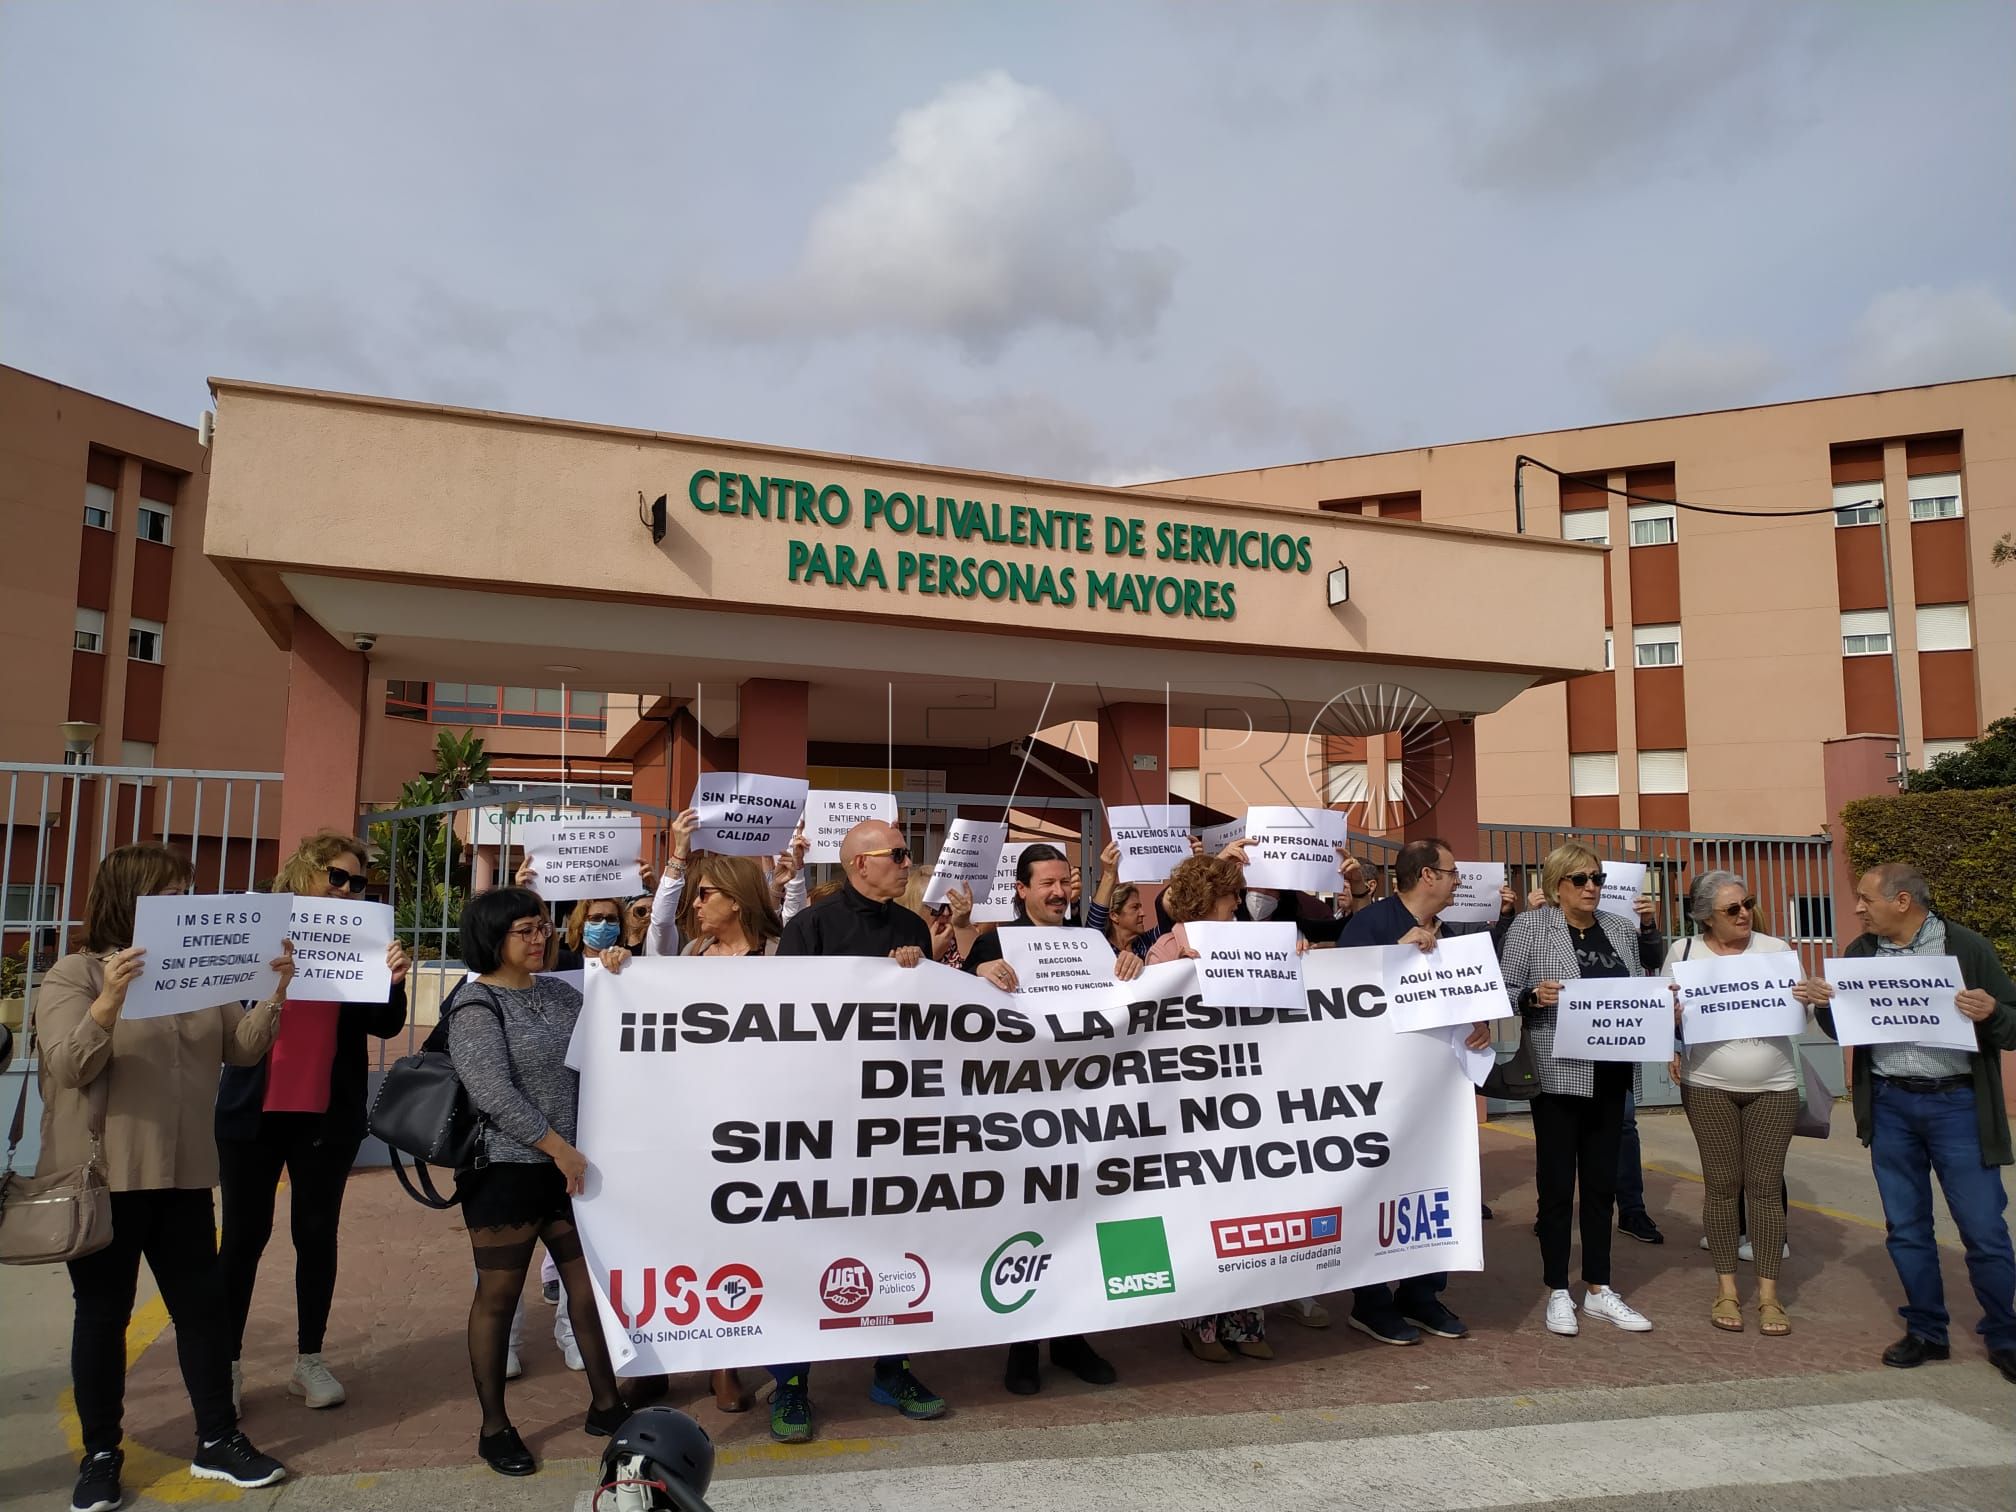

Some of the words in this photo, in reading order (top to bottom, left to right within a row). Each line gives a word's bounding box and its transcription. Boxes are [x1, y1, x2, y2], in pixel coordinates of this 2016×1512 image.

[689, 469, 850, 525] CENTRO
[864, 488, 1092, 551] POLIVALENTE
[1105, 516, 1145, 557] DE
[1156, 521, 1312, 572] SERVICIOS
[788, 539, 888, 589] PARA
[898, 550, 1076, 604] PERSONAS
[1086, 569, 1236, 619] MAYORES
[702, 791, 725, 803] SIN
[729, 794, 797, 810] PERSONAL
[724, 812, 744, 823] NO
[747, 813, 774, 825] HAY
[552, 831, 616, 841] IMSERSO
[716, 829, 770, 842] CALIDAD
[818, 827, 832, 835] SIN
[1117, 829, 1169, 840] SALVEMOS
[1170, 830, 1177, 838] A
[1178, 830, 1187, 838] LA
[1273, 836, 1329, 848] PERSONAL
[1332, 840, 1343, 848] NO
[558, 845, 609, 855] ENTIENDE
[1129, 845, 1183, 856] RESIDENCIA
[1264, 851, 1287, 859] HAY
[1291, 852, 1334, 863] CALIDAD
[546, 861, 563, 870] SIN
[566, 859, 620, 869] PERSONAL
[545, 875, 560, 884] NO
[562, 874, 576, 883] SE
[579, 872, 622, 882] ATIENDE
[177, 912, 261, 926] IMSERSO
[183, 933, 251, 947] ENTIENDE
[1028, 941, 1088, 951] IMSERSO
[161, 959, 186, 970] SIN
[189, 953, 260, 968] PERSONAL
[1038, 956, 1083, 965] REACCIONA
[1211, 949, 1241, 960] AQUÍ
[1244, 951, 1261, 960] NO
[1265, 952, 1288, 961] HAY
[304, 968, 364, 980] ATIENDE
[1051, 970, 1091, 978] PERSONAL
[1205, 969, 1244, 978] QUIEN
[1247, 969, 1297, 980] TRABAJE
[1400, 969, 1432, 985] AQUÍ
[1436, 970, 1453, 980] NO
[1456, 965, 1483, 978] HAY
[155, 979, 175, 992] NO
[180, 977, 198, 989] SE
[201, 971, 257, 987] ATIENDE
[1028, 986, 1060, 994] CENTRO
[1075, 981, 1114, 990] FUNCIONA
[1838, 980, 1864, 991] SIN
[1869, 978, 1954, 990] PERSONAL
[1395, 989, 1437, 1004] QUIEN
[1440, 981, 1498, 997] TRABAJE
[1685, 981, 1759, 999] SALVEMOS
[1765, 980, 1774, 989] A
[1779, 978, 1796, 989] LA
[1569, 1000, 1593, 1011] SIN
[1596, 998, 1665, 1010] PERSONAL
[1700, 997, 1786, 1015] RESIDENCIA
[1870, 997, 1893, 1007] NO
[1900, 997, 1930, 1006] HAY
[1045, 1011, 1115, 1042] LA
[1592, 1018, 1612, 1028] NO
[1616, 1017, 1644, 1028] HAY
[1871, 1015, 1940, 1026] CALIDAD
[1587, 1036, 1646, 1046] CALIDAD
[861, 1059, 945, 1099] DE
[961, 1042, 1263, 1097] MAYORES!!!
[711, 1120, 833, 1164] SIN
[856, 1101, 1167, 1158] PERSONAL
[1179, 1092, 1262, 1134] NO
[1277, 1081, 1383, 1124] HAY
[710, 1170, 1005, 1224] CALIDAD
[1023, 1163, 1080, 1204] NI
[1095, 1131, 1391, 1196] SERVICIOS
[1218, 1218, 1306, 1251] CCOO
[995, 1253, 1052, 1286] CSIF
[1218, 1259, 1267, 1273] servicios
[1270, 1258, 1276, 1266] a
[1279, 1255, 1288, 1264] la
[1316, 1258, 1341, 1271] melilla
[828, 1266, 866, 1289] UGT
[878, 1270, 917, 1282] Servicios
[1108, 1271, 1172, 1294] SATSE
[879, 1283, 916, 1295] Públicos
[610, 1263, 764, 1329] USO
[859, 1315, 895, 1327] Melilla
[657, 1329, 713, 1342] SINDICAL
[716, 1325, 763, 1338] OBRERA
